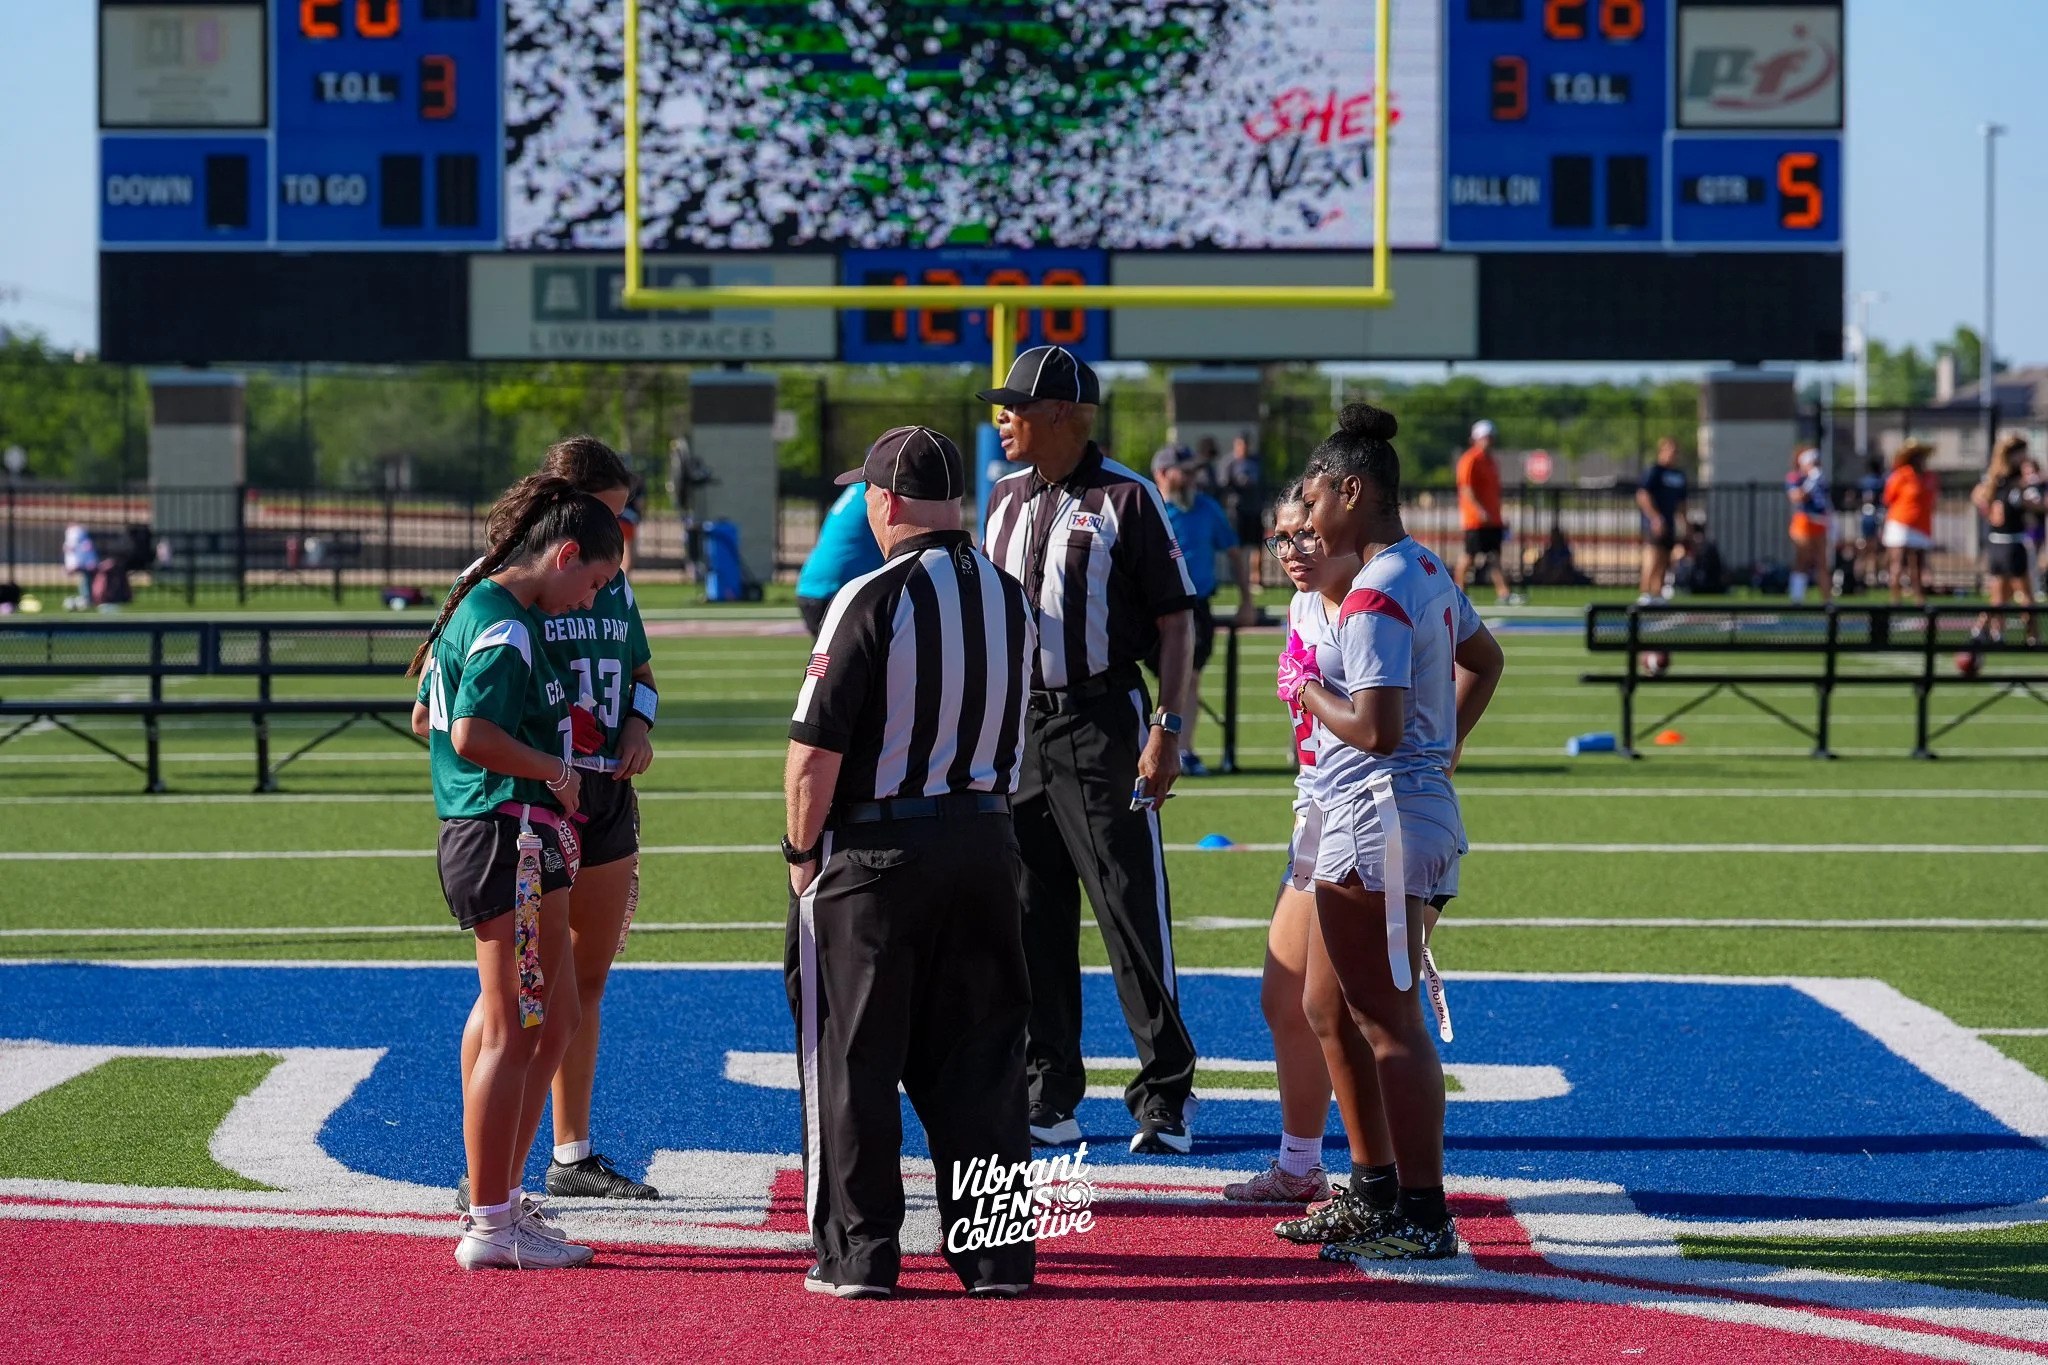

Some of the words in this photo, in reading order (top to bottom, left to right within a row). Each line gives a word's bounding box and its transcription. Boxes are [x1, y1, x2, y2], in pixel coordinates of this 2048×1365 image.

[421, 53, 458, 119] 3
[1491, 54, 1528, 120] 3
[106, 174, 193, 206] DOWN
[283, 175, 321, 205] TO
[325, 174, 367, 206] GO
[1697, 175, 1750, 205] QTR
[1777, 152, 1823, 229] 5
[530, 327, 645, 352] LIVING
[658, 327, 776, 352] SPACES
[545, 618, 597, 641] CEDAR
[570, 657, 622, 728] 13
